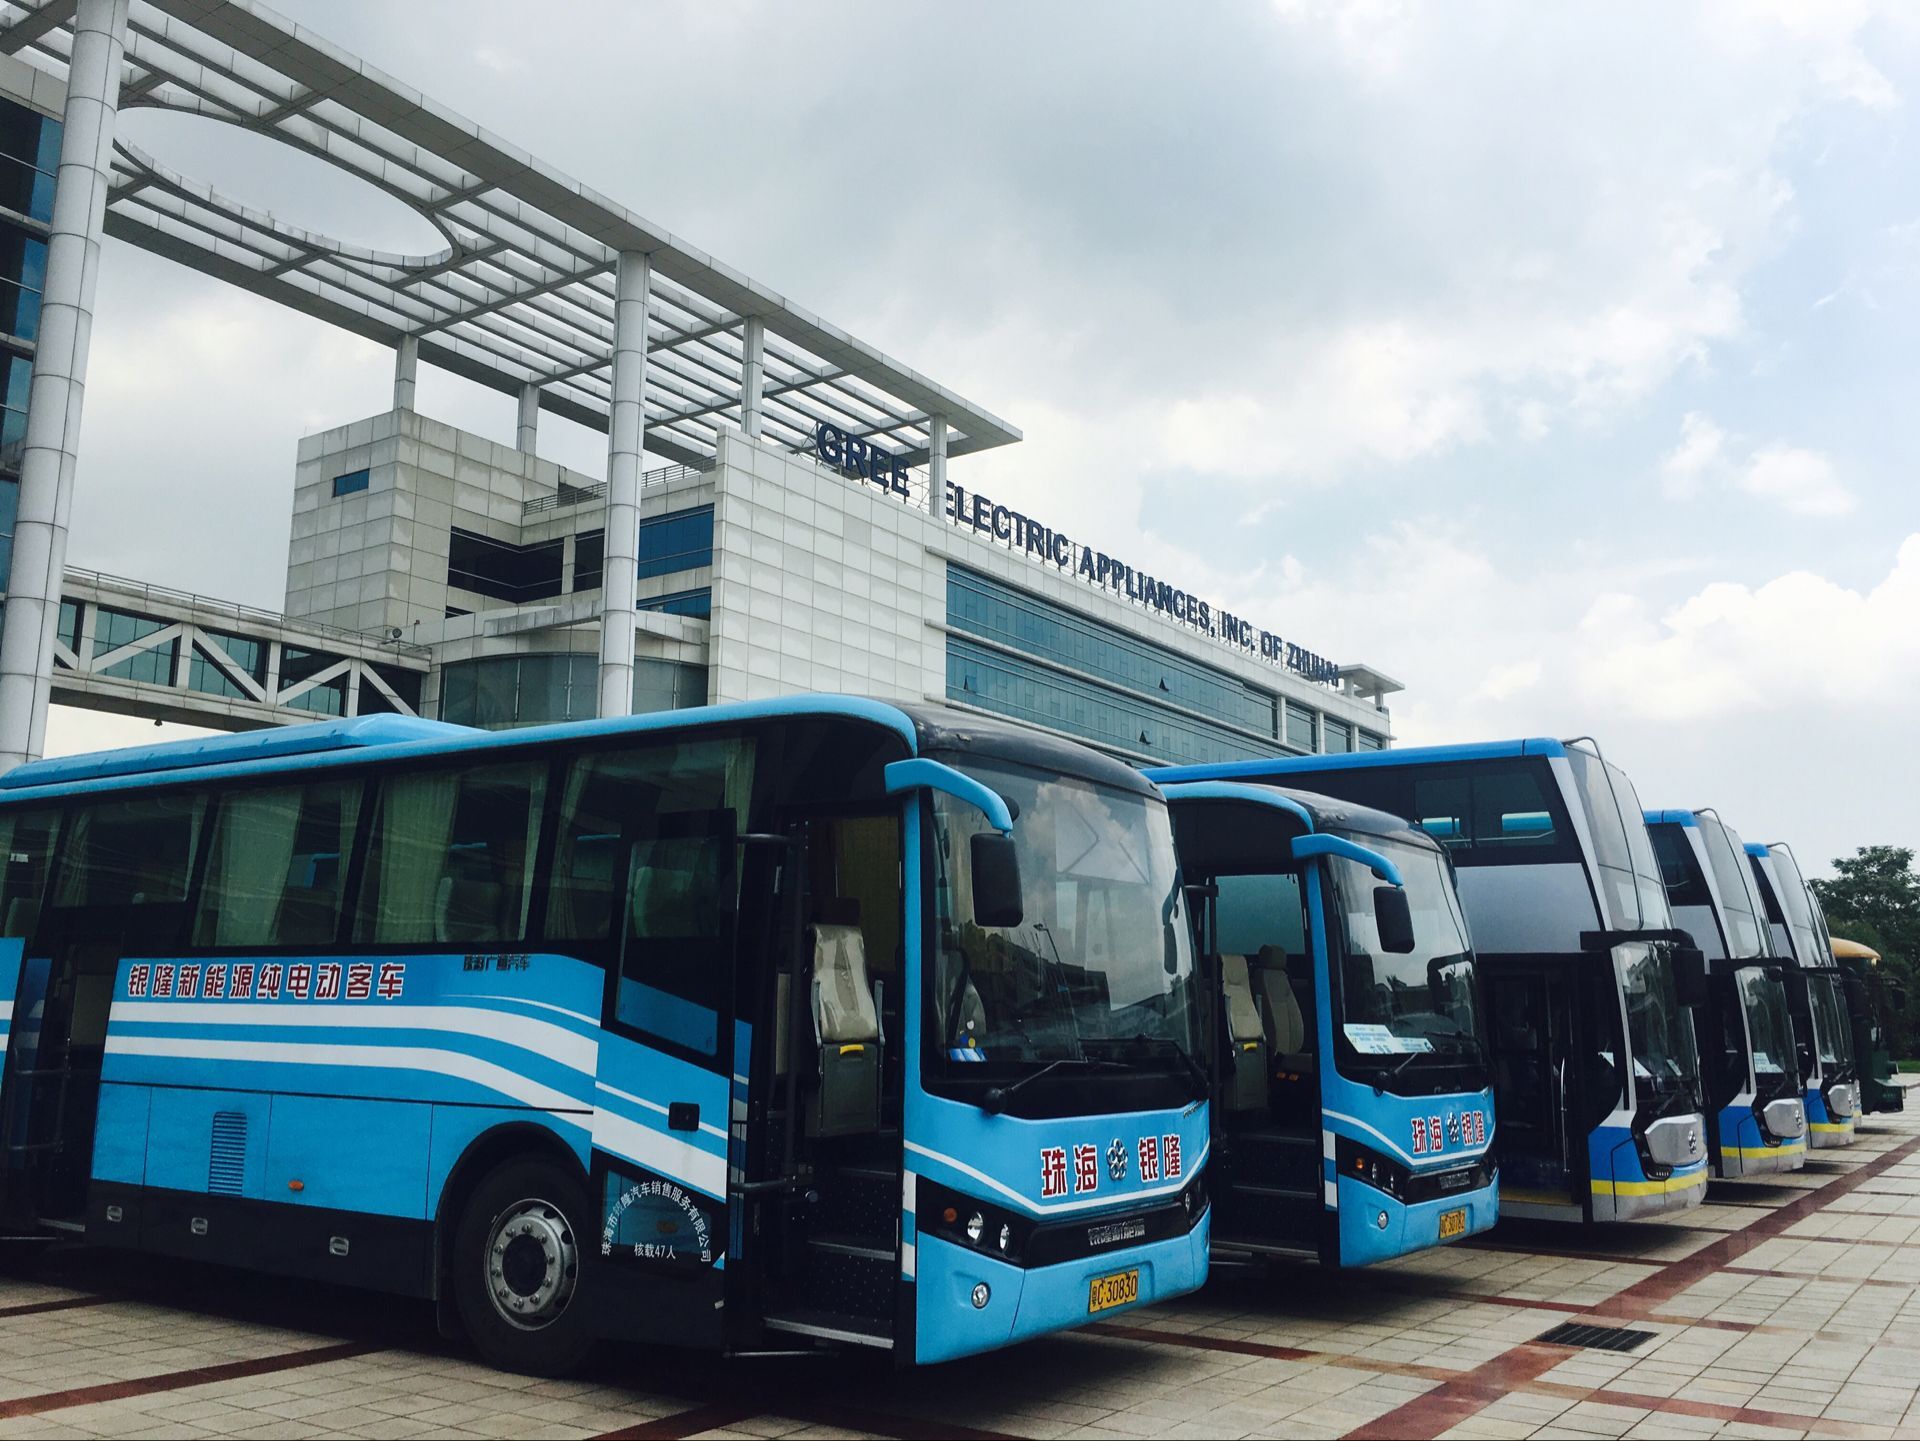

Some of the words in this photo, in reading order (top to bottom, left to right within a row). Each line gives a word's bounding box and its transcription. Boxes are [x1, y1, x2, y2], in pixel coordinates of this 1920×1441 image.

[817, 423, 910, 497] GREE
[1079, 546, 1215, 637] APPLIANCES,
[1222, 611, 1255, 650] INC.
[1261, 631, 1282, 660] OF
[128, 963, 406, 999] 银隆新能源纯电动客车
[1410, 1115, 1443, 1154] 珠海
[1040, 1143, 1099, 1199] 珠海
[1138, 1134, 1182, 1183] 银隆
[634, 1242, 676, 1259] 核载47人
